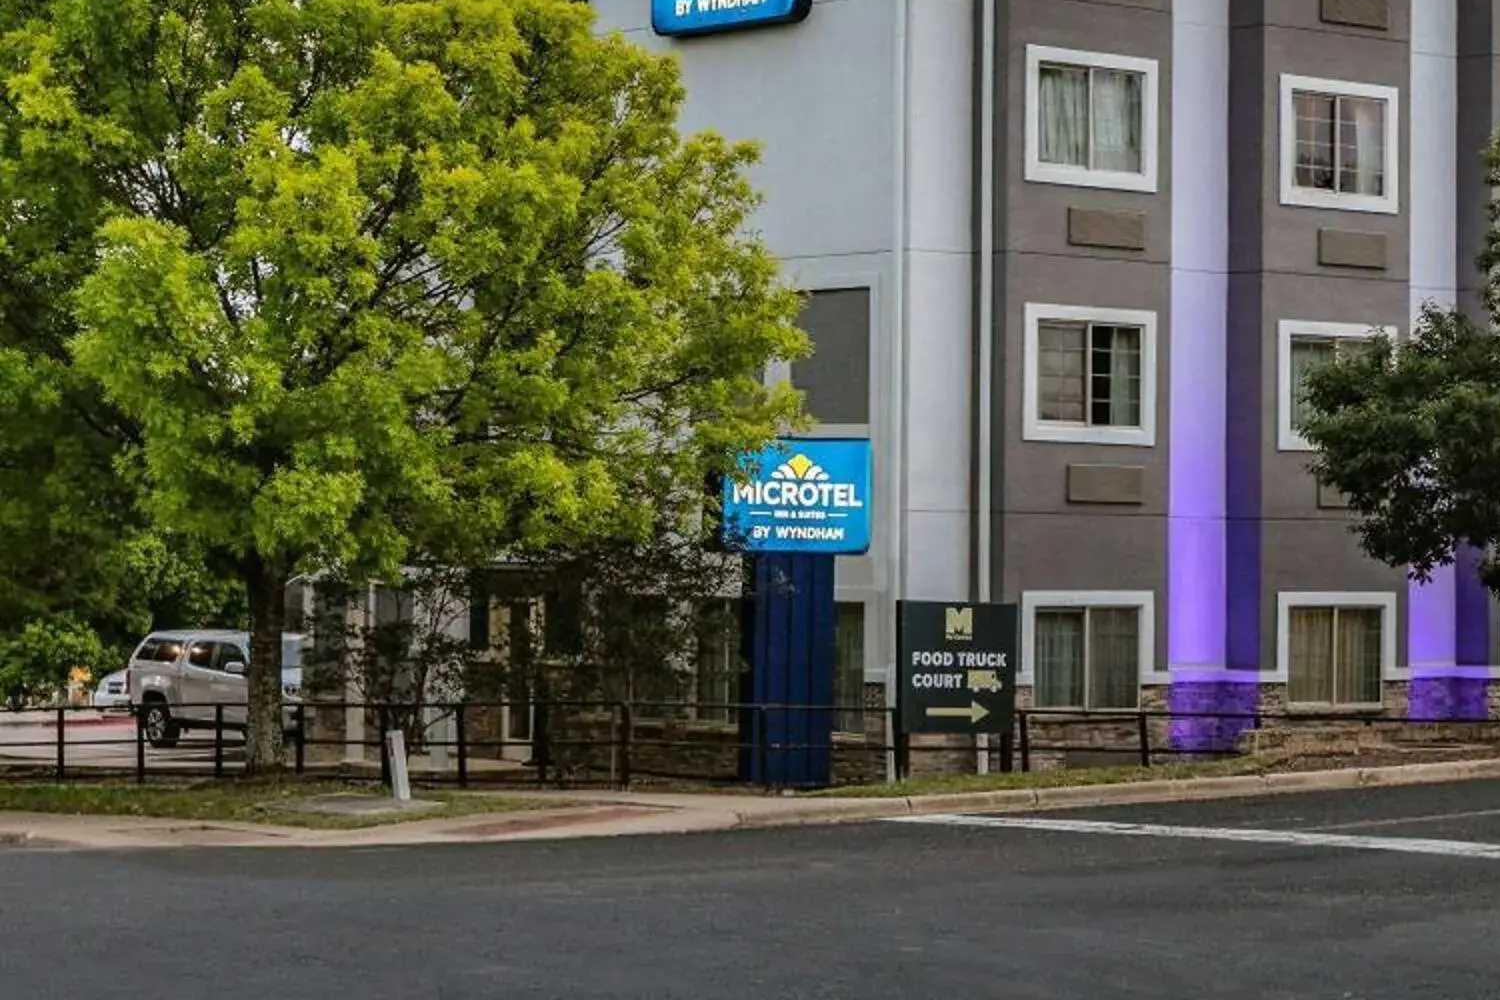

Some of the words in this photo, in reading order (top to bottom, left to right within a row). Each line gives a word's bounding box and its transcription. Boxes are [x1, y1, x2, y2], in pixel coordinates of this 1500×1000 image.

[733, 481, 863, 507] MICROTEL
[753, 525, 771, 539] BY
[776, 525, 844, 540] WYNDHAM
[945, 607, 973, 633] M
[911, 651, 954, 666] FOOD
[958, 652, 1007, 668] TRUCK
[911, 673, 963, 688] COURT
